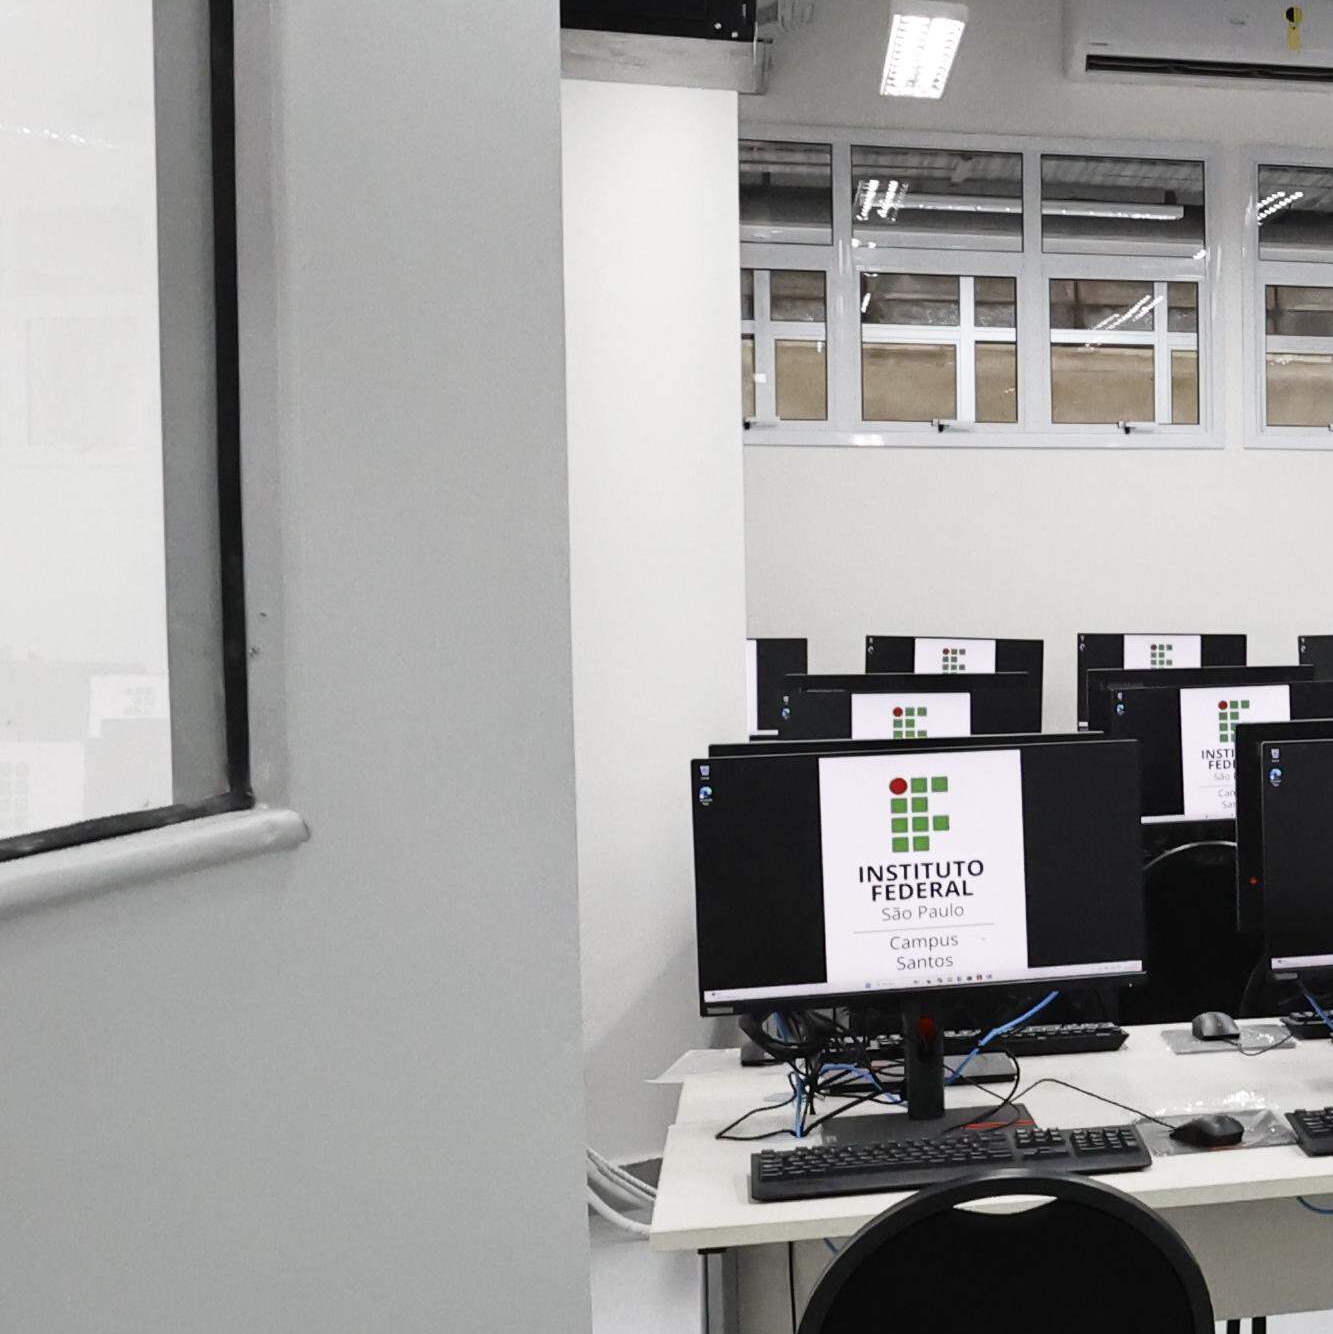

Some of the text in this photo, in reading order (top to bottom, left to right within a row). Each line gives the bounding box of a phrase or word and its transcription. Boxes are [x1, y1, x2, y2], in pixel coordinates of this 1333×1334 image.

[1201, 748, 1235, 760] INSTI
[859, 859, 985, 883] INSTITUTO
[872, 880, 974, 902] FEDERAL
[881, 903, 965, 922] São Paulo
[890, 934, 959, 952] Campus
[896, 955, 954, 971] Santos
